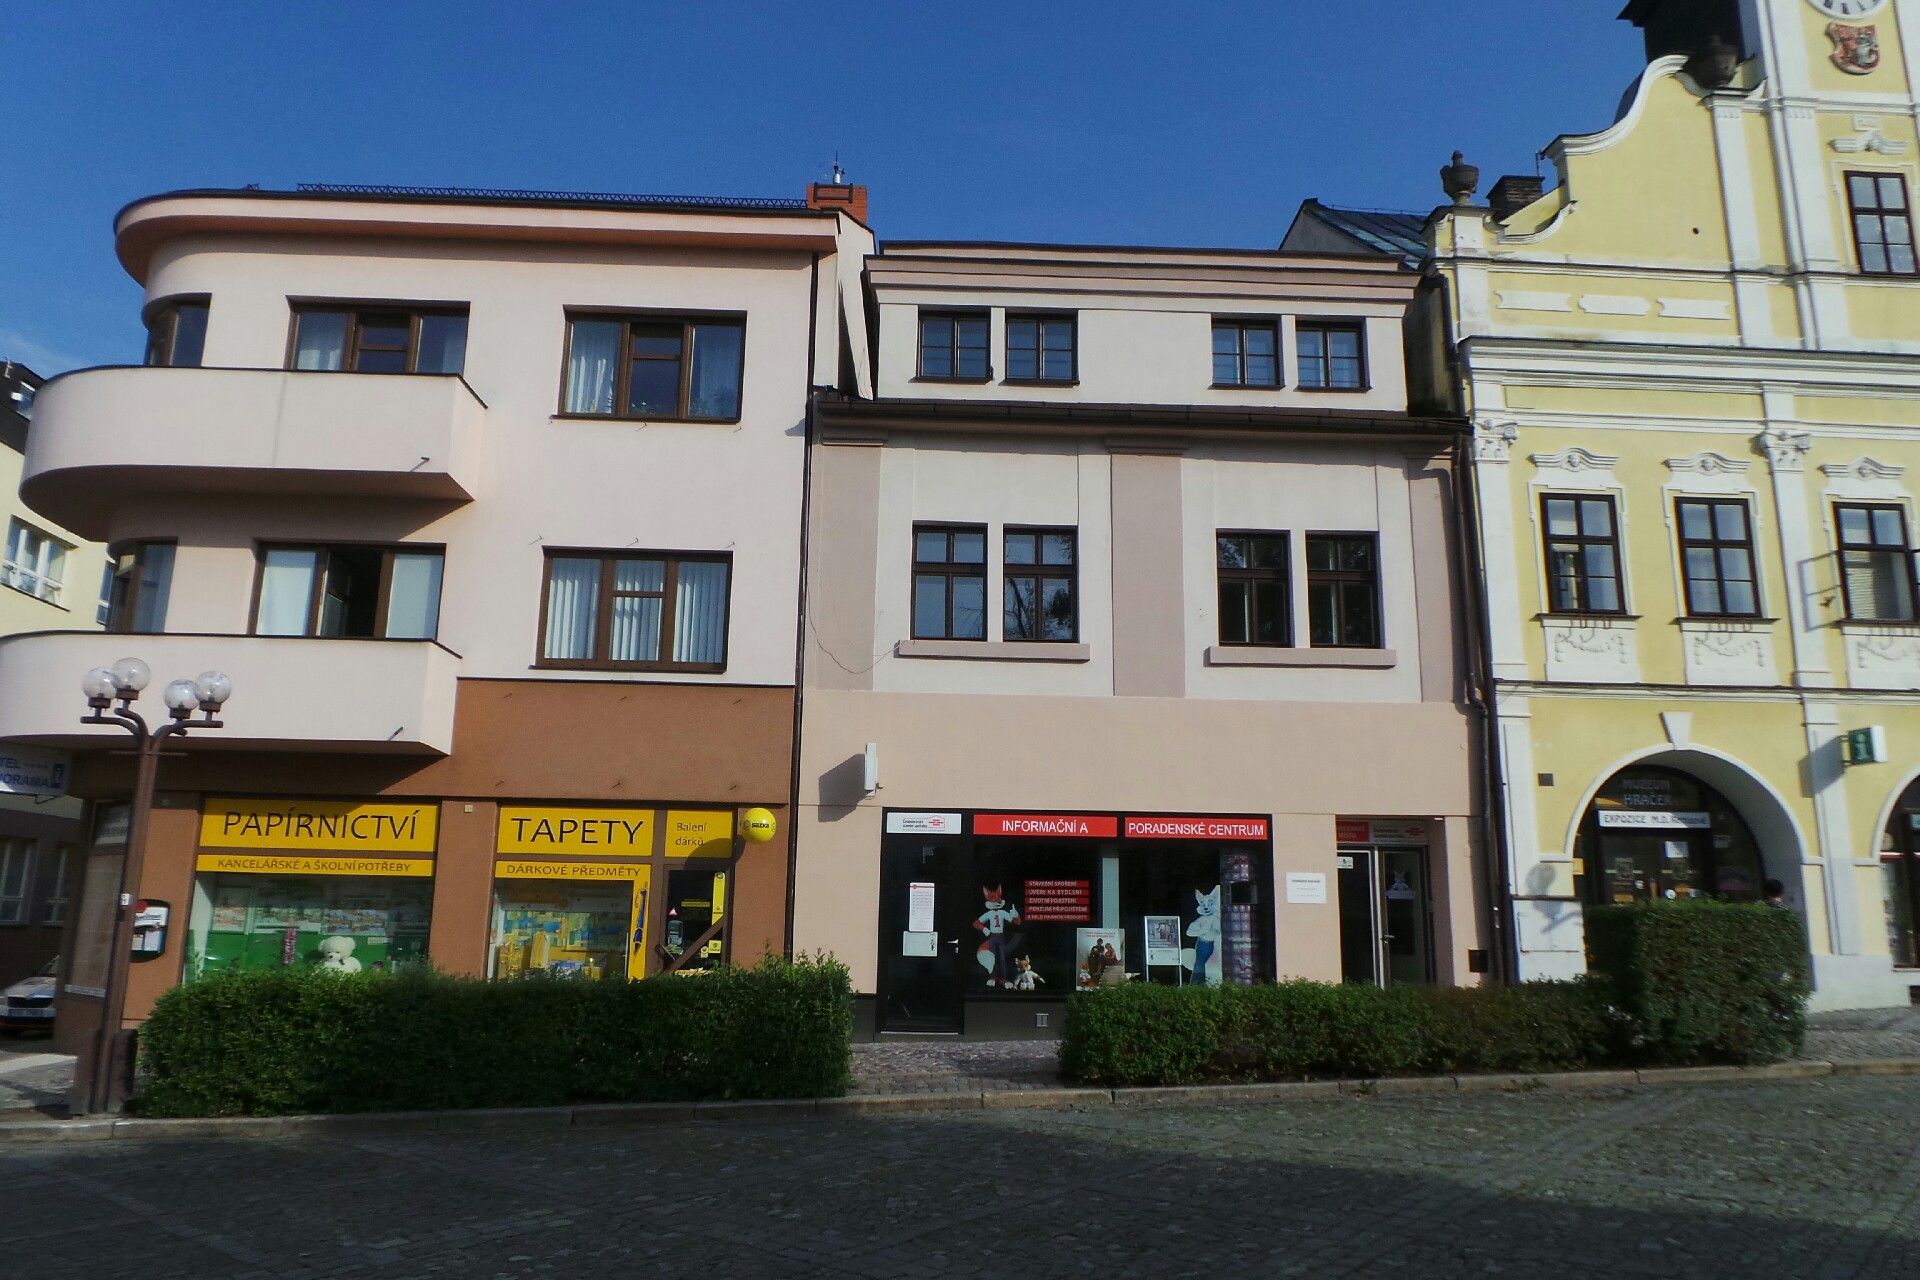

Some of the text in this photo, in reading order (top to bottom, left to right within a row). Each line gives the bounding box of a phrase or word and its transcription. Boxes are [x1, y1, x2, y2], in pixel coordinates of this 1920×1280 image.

[223, 806, 421, 840] PAPÍRNICTVÍ
[1001, 818, 1089, 834] INFORMAČNÍ A
[1603, 814, 1647, 824] EXPOZICE
[510, 817, 644, 845] TAPETY
[676, 822, 708, 832] Balení
[1128, 821, 1264, 836] PORADENSKÉ CENTRUM
[675, 836, 704, 847] dárků
[217, 858, 411, 873] KANCELÁŘSKÉ A ŠKOLNÍ POTŘEBY
[506, 863, 642, 878] DÁRKOVÉ PŘEDMĚTY
